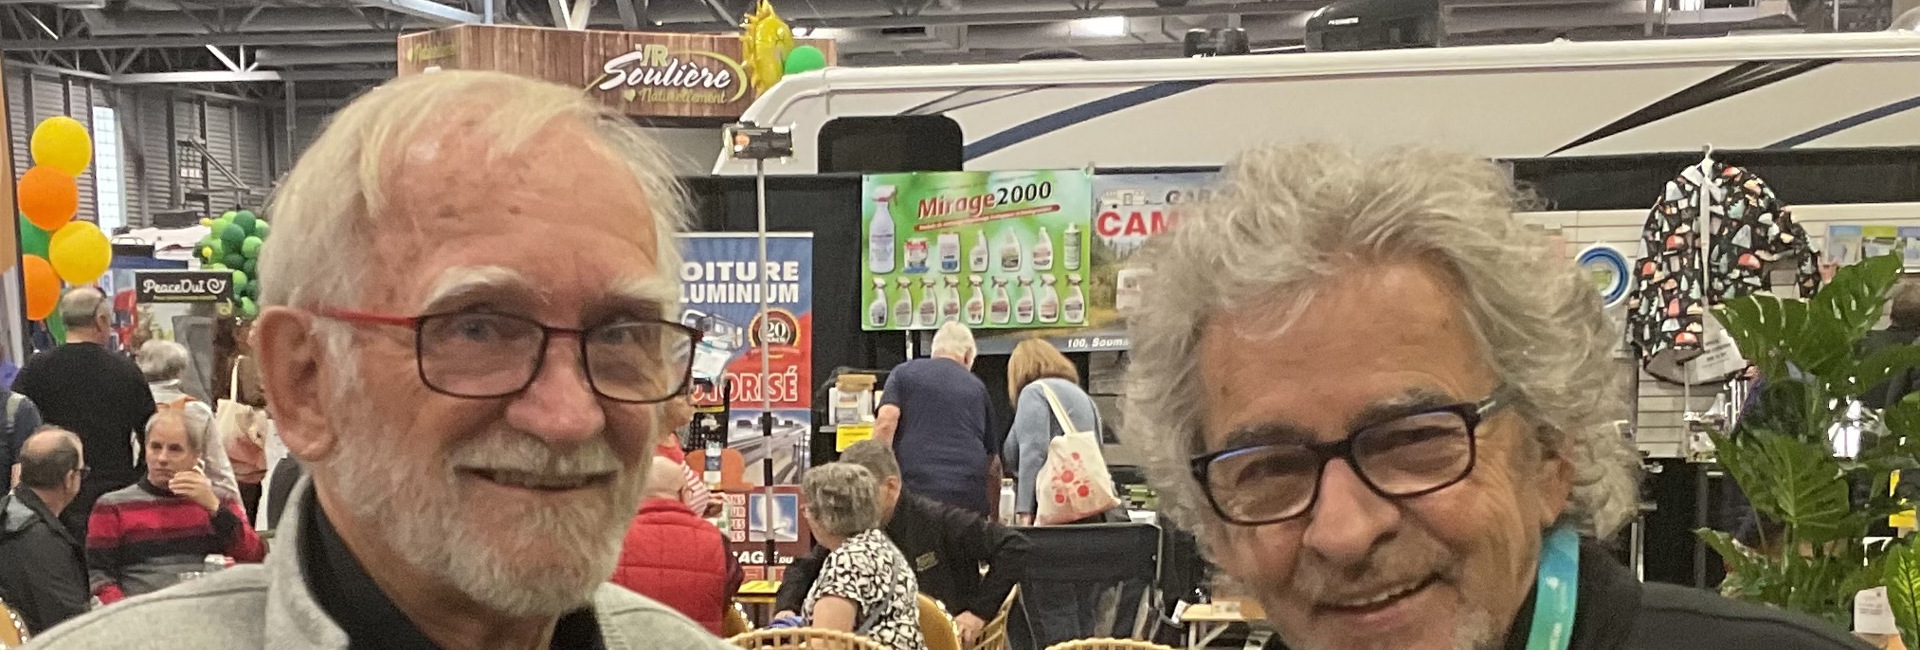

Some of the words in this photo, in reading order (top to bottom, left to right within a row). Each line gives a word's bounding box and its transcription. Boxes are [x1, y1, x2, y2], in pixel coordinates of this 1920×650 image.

[635, 44, 669, 67] VR
[599, 51, 731, 90] Soulière
[917, 181, 1052, 220] Mirage2000
[679, 261, 799, 282] OITURE
[766, 321, 787, 339] 20
[1067, 338, 1089, 348] 100,
